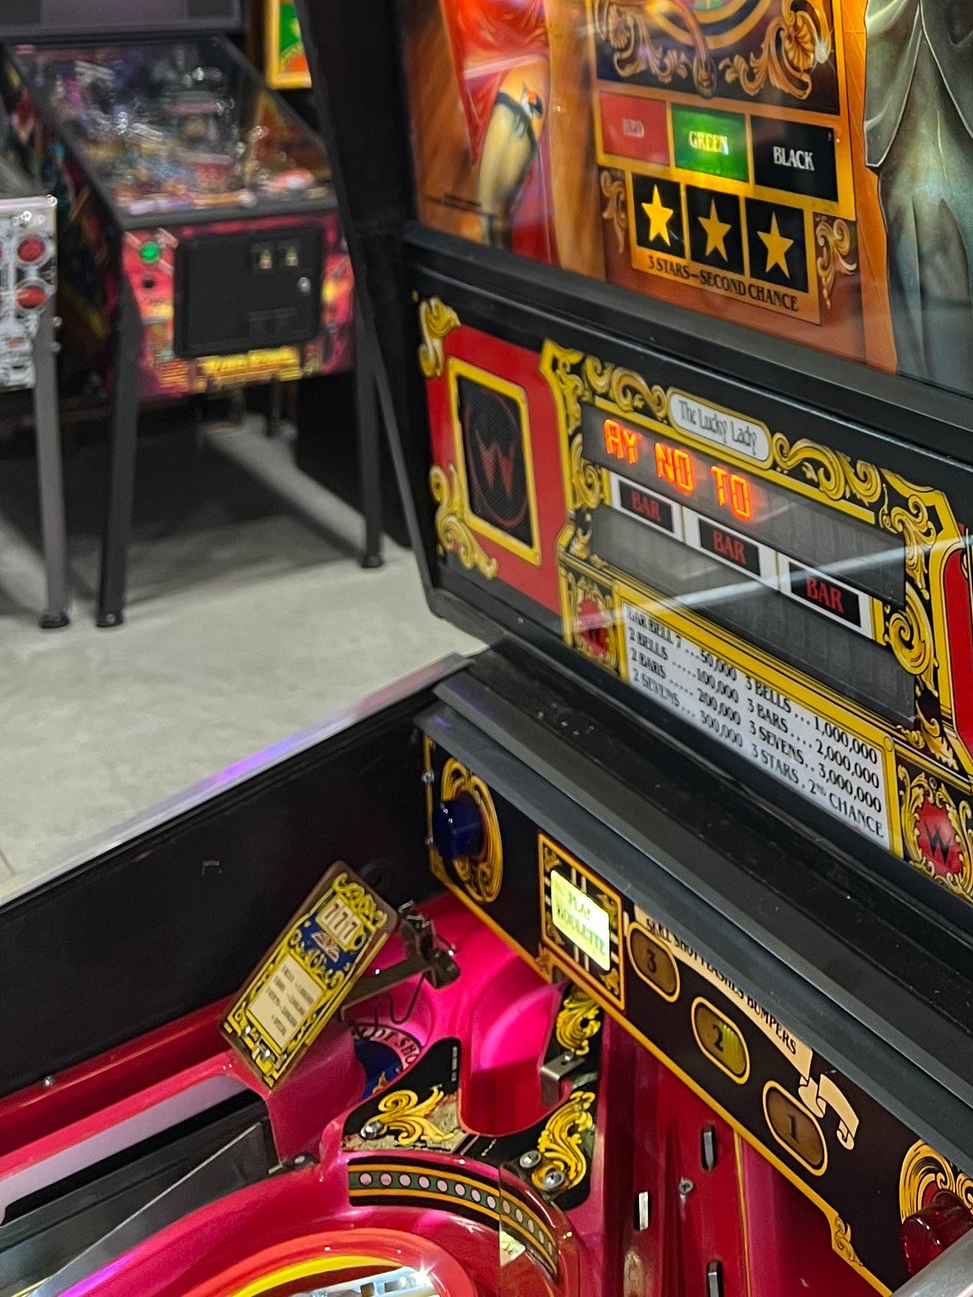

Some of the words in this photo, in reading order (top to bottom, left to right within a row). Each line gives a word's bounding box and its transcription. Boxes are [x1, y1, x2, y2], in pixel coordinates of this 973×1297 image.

[688, 130, 729, 155] GREEN
[773, 146, 815, 171] BLACK
[657, 259, 690, 280] STARS
[700, 269, 746, 296] SECOND
[747, 284, 799, 312] CHANCE
[679, 399, 697, 425] The
[699, 405, 728, 444] Lucky
[730, 422, 758, 456] Lady
[603, 418, 638, 465] AY
[655, 442, 694, 493] NO
[711, 465, 752, 521] TO
[631, 490, 662, 522] BAR
[712, 530, 746, 565] BAR
[805, 576, 844, 615] BAR
[747, 698, 755, 713] 3
[757, 702, 789, 734] BARS
[816, 738, 880, 789] 2,000,000
[755, 678, 791, 713] BELLS
[814, 716, 878, 765] 1,000,000
[749, 720, 757, 735] 3
[759, 725, 804, 765] SEVENS
[818, 762, 882, 814] 3,000,000
[752, 743, 759, 759] 3
[761, 748, 799, 785] STARS
[829, 792, 884, 839] CHANCE
[646, 948, 657, 974] 3
[712, 1023, 724, 1053] 2
[747, 995, 797, 1055] BUMPERS
[788, 1114, 799, 1142] 1
